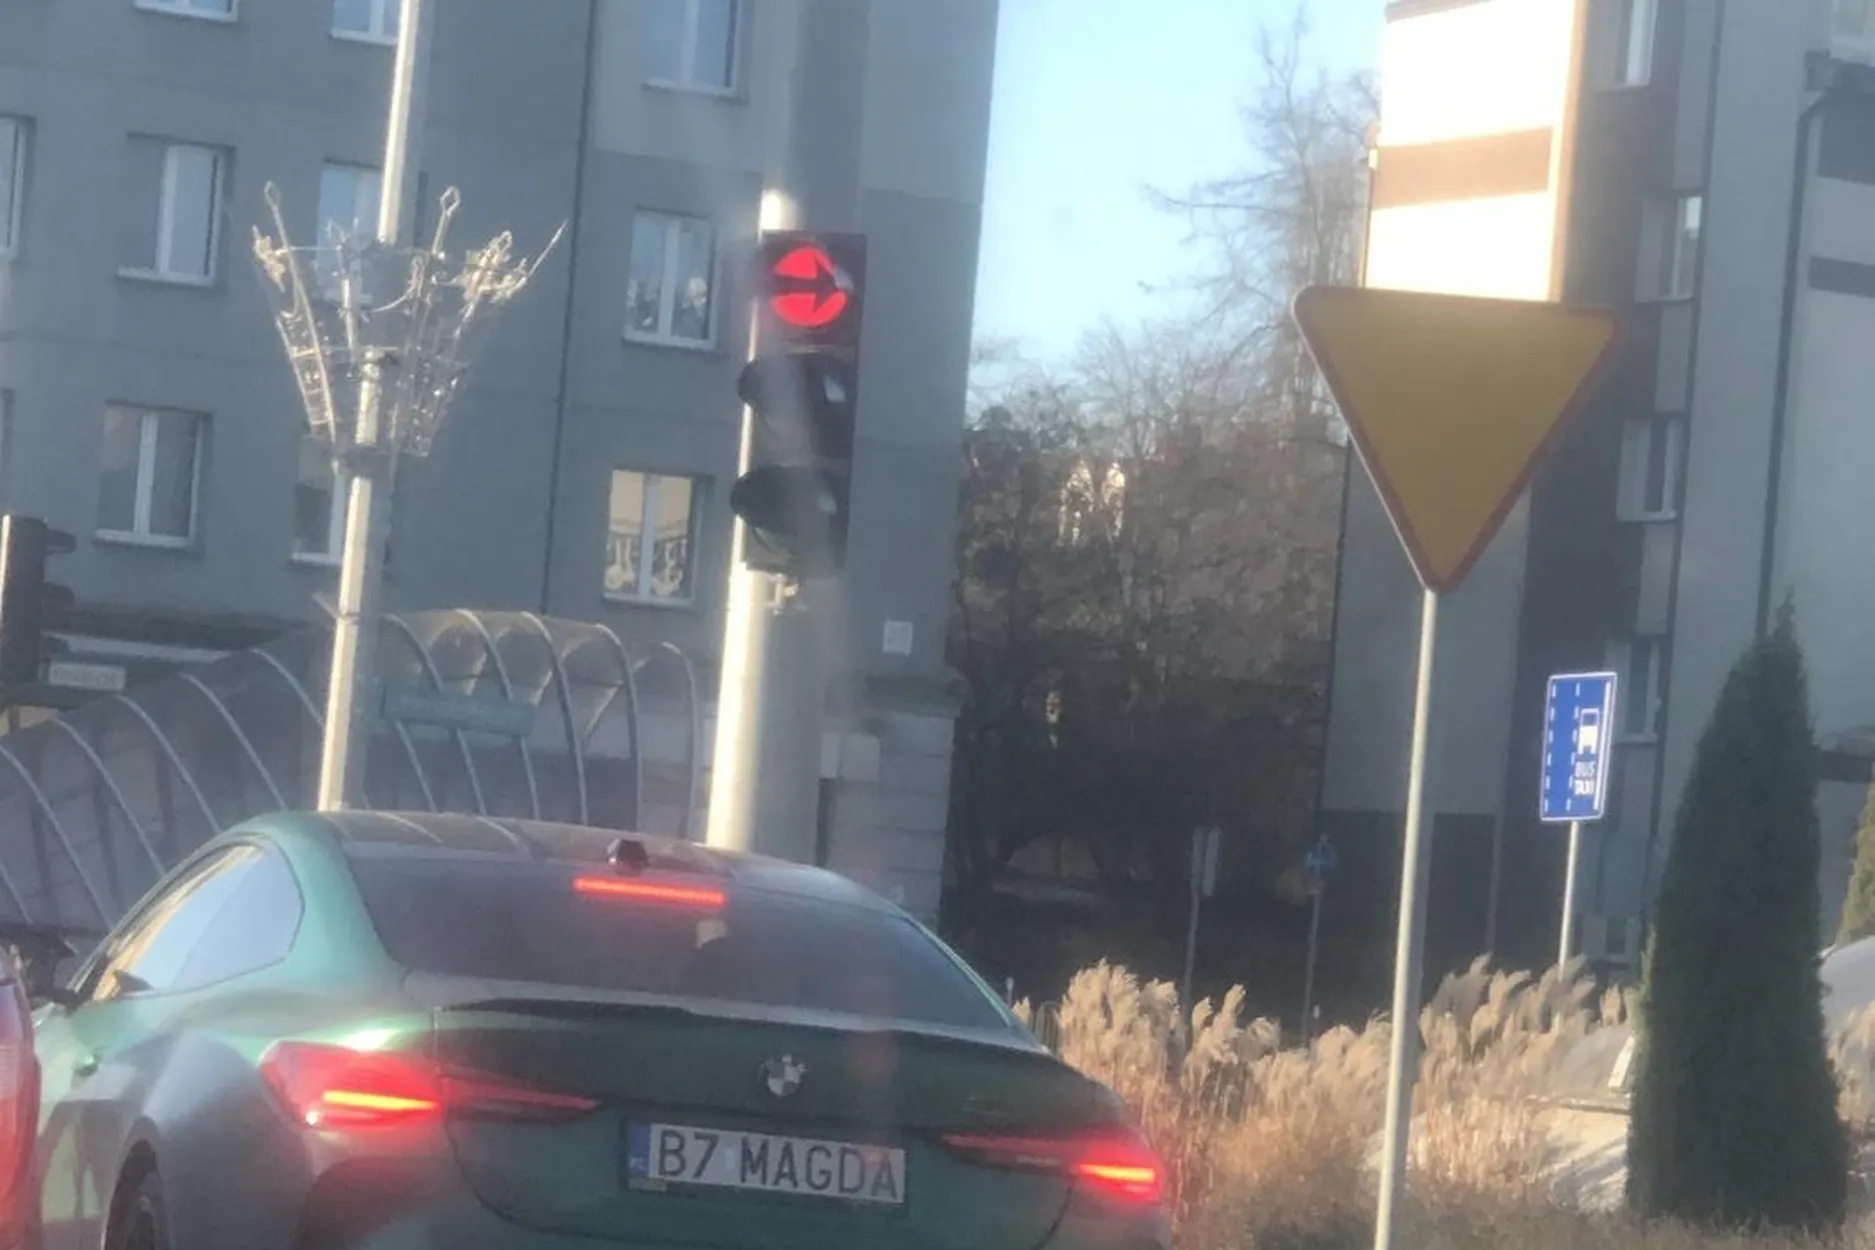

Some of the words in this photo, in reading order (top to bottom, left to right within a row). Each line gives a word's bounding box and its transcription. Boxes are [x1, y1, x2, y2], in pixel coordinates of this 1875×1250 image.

[1574, 761, 1596, 777] BUS
[657, 1129, 720, 1179] B7
[740, 1135, 897, 1199] MAGDA
